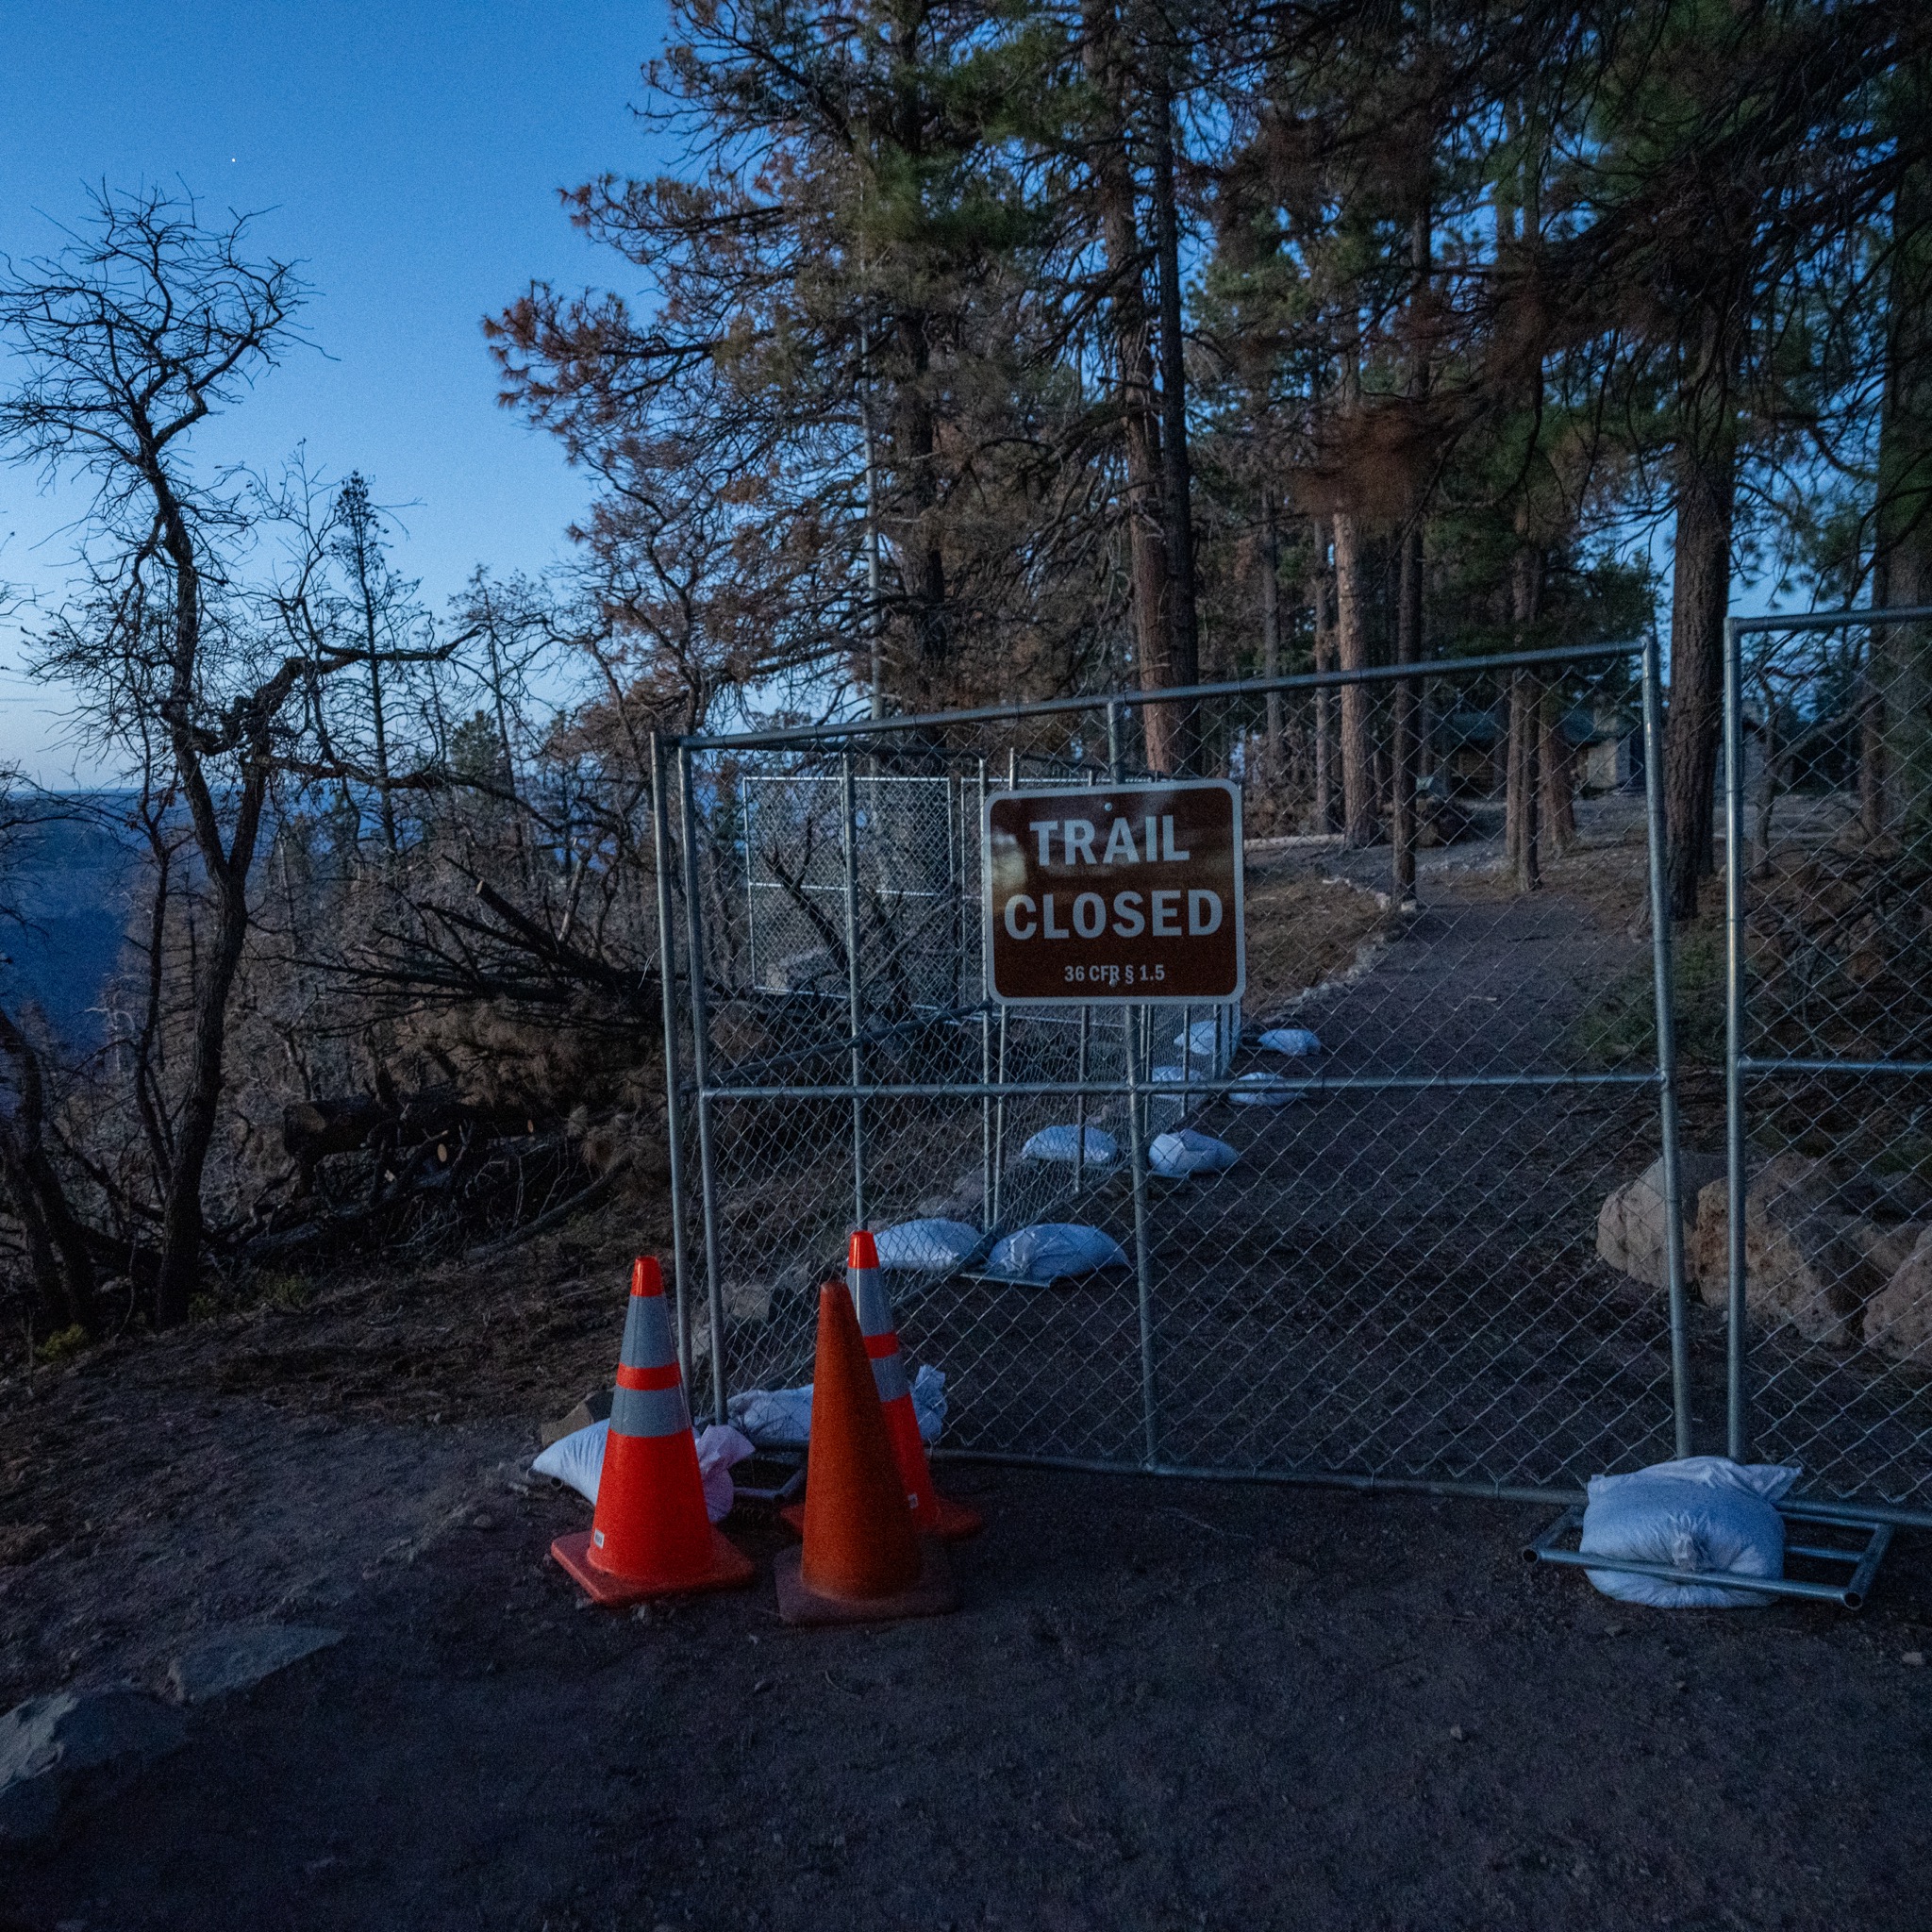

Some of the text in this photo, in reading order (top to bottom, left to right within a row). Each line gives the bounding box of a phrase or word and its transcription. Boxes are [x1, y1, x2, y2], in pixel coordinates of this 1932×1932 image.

[1029, 814, 1190, 867] TRAIL
[1004, 889, 1224, 941] CLOSED
[1064, 963, 1165, 985] 36 CFR § 1.5
